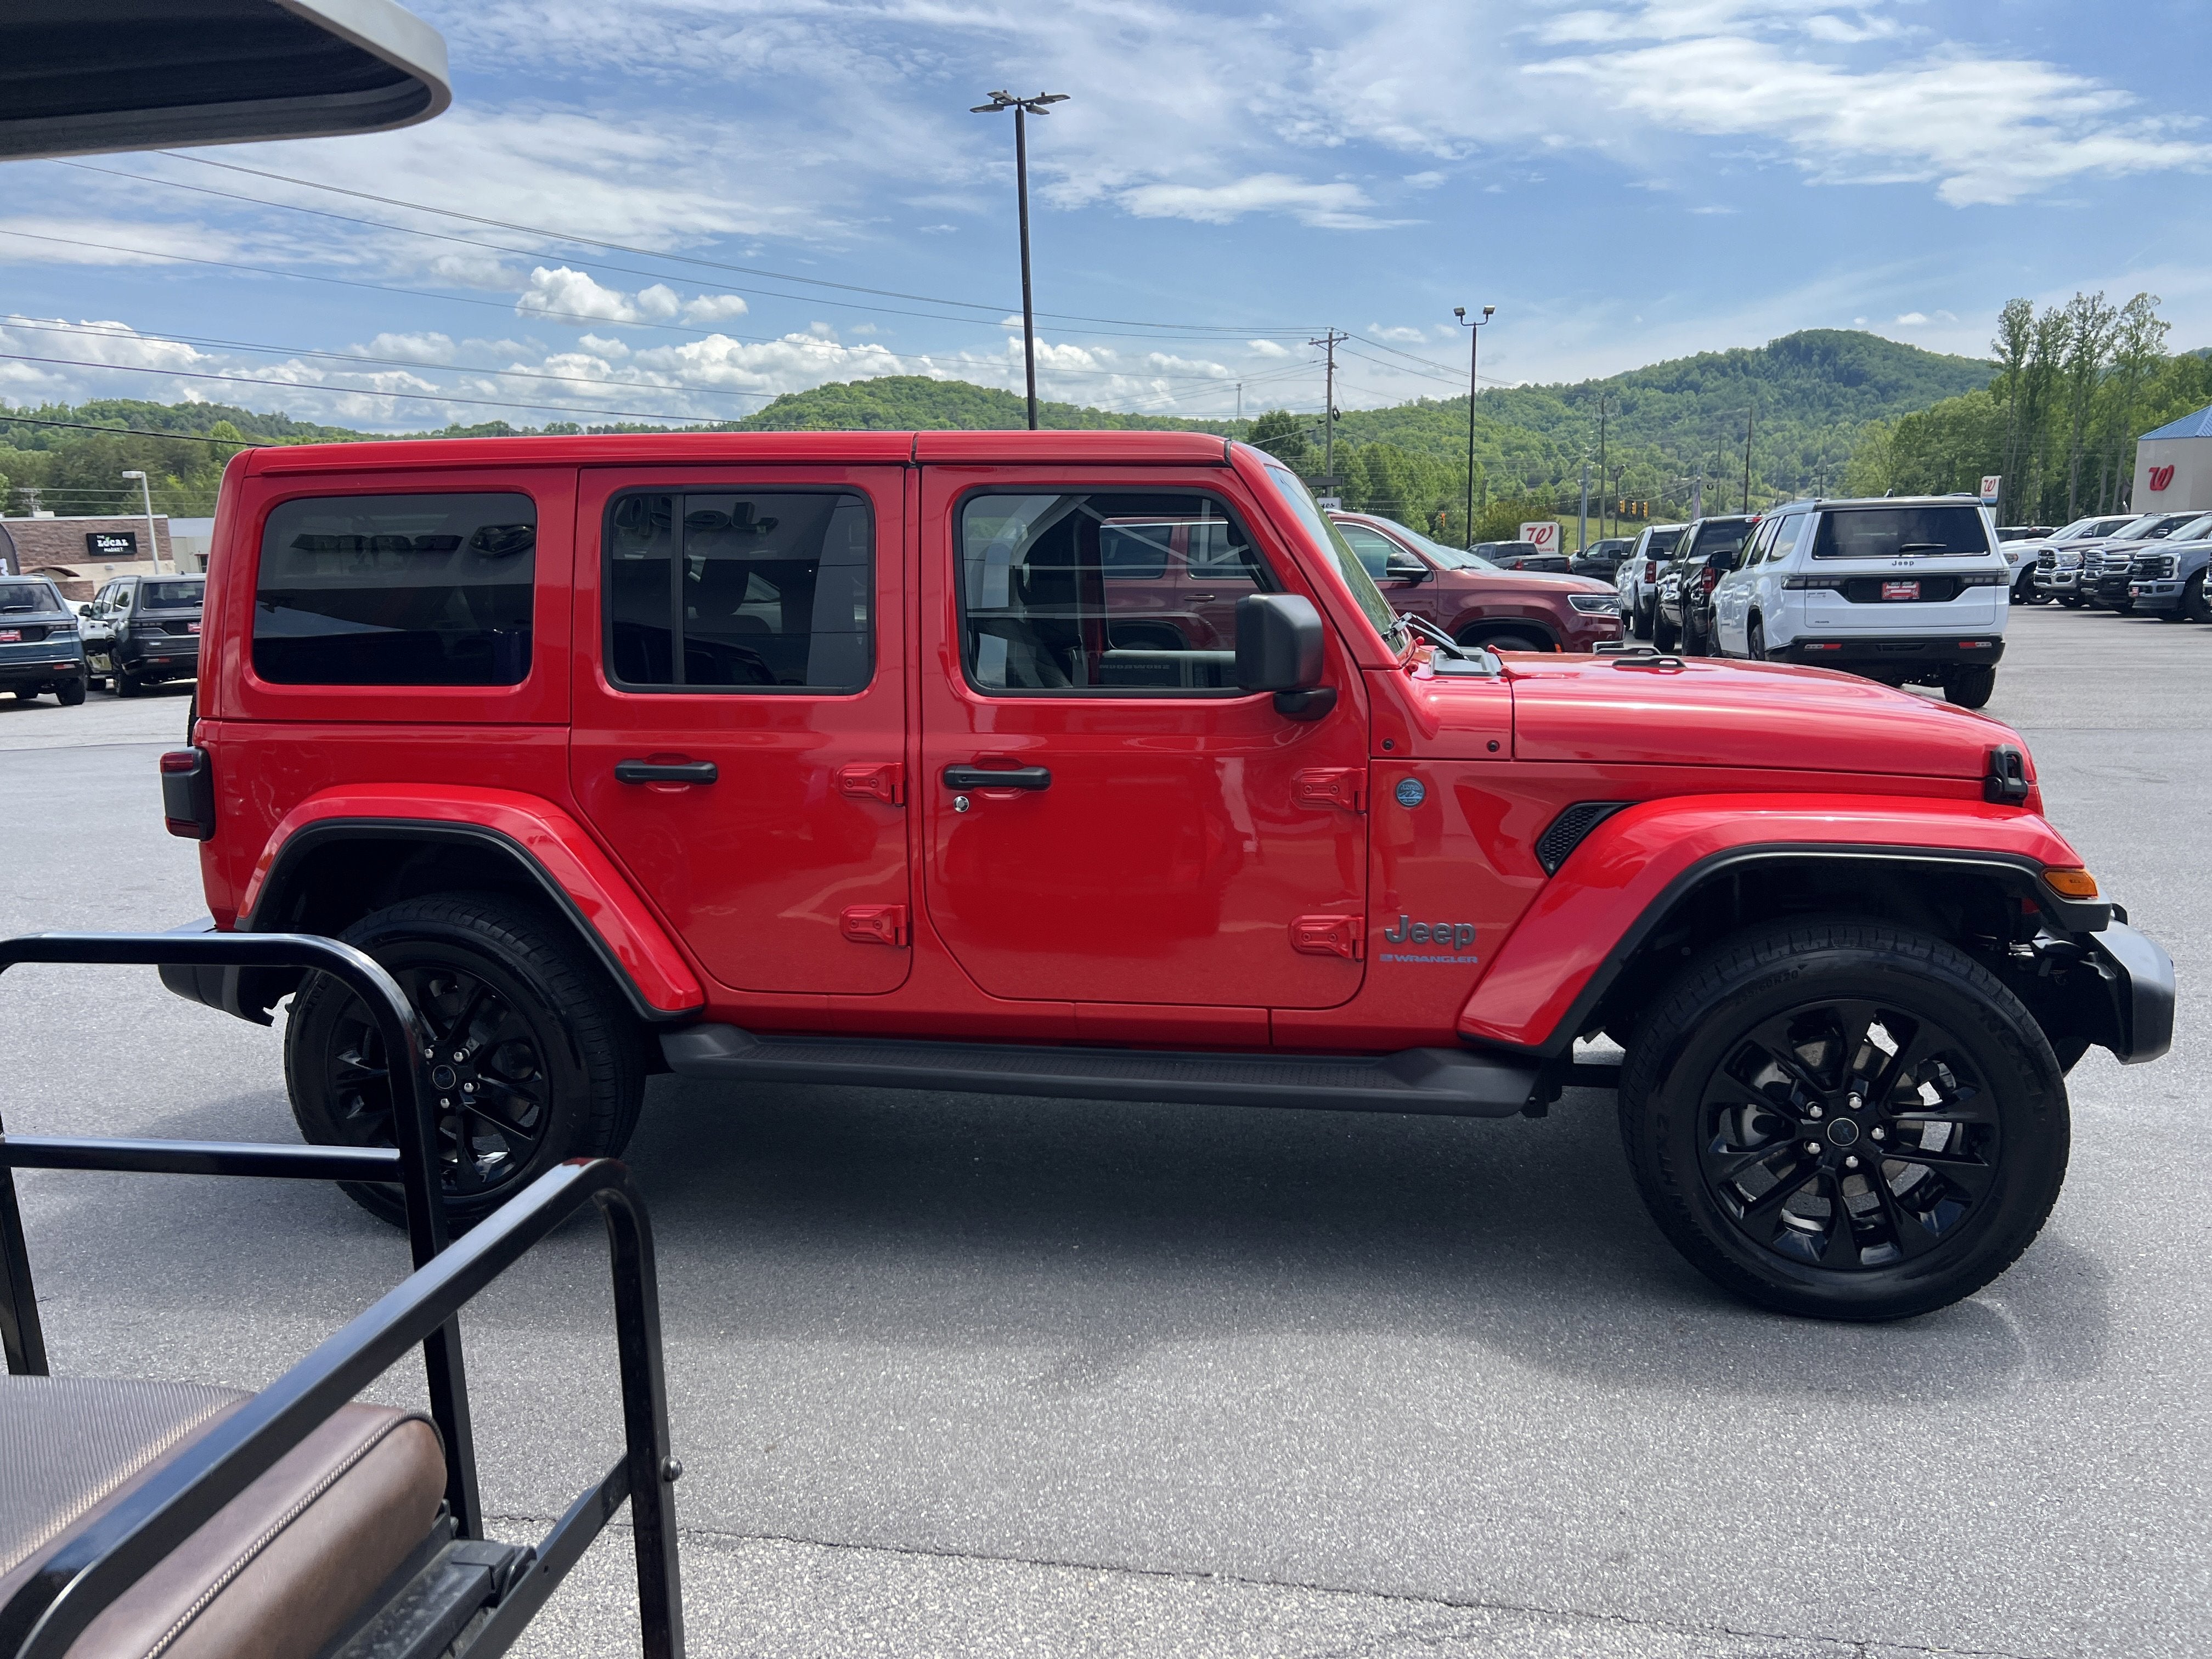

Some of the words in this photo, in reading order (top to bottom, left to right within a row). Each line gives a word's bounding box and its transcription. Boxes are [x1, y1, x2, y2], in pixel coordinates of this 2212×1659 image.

[97, 539, 129, 547] LOCAL
[1385, 915, 1476, 950] Jeep
[1395, 954, 1479, 963] WRANGLER
